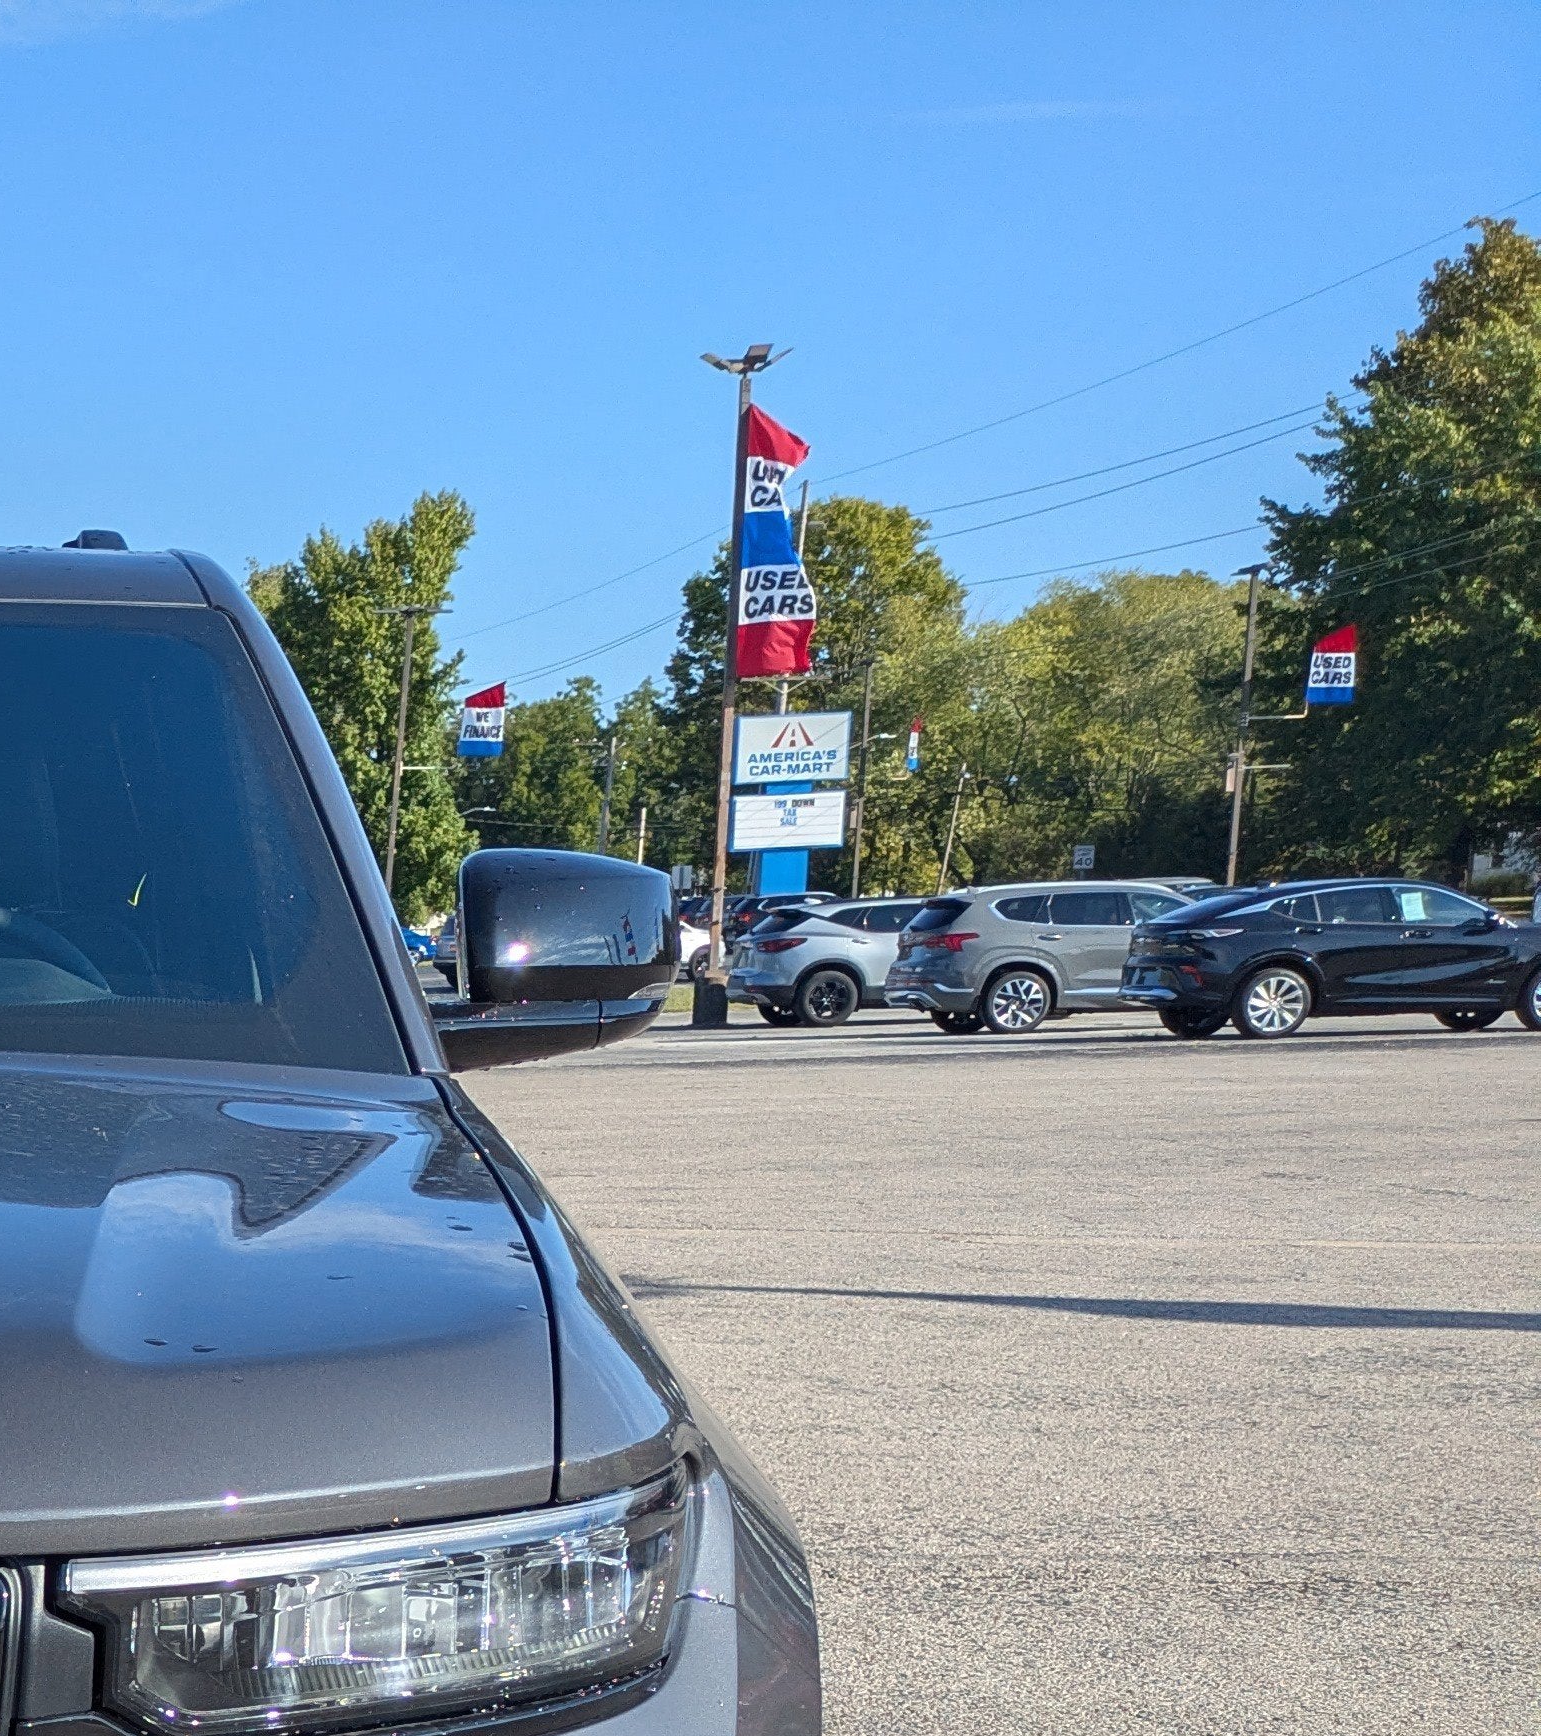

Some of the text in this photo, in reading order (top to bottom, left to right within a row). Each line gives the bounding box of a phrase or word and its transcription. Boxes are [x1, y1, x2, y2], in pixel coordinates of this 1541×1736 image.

[750, 485, 783, 507] CA
[744, 594, 814, 619] CARS
[1313, 655, 1352, 669] USED
[1311, 671, 1352, 685] CARS
[463, 725, 502, 739] FINANCE
[747, 750, 837, 763] AMERICA'S
[749, 762, 834, 776] CAR-MART
[1075, 857, 1093, 867] 40
